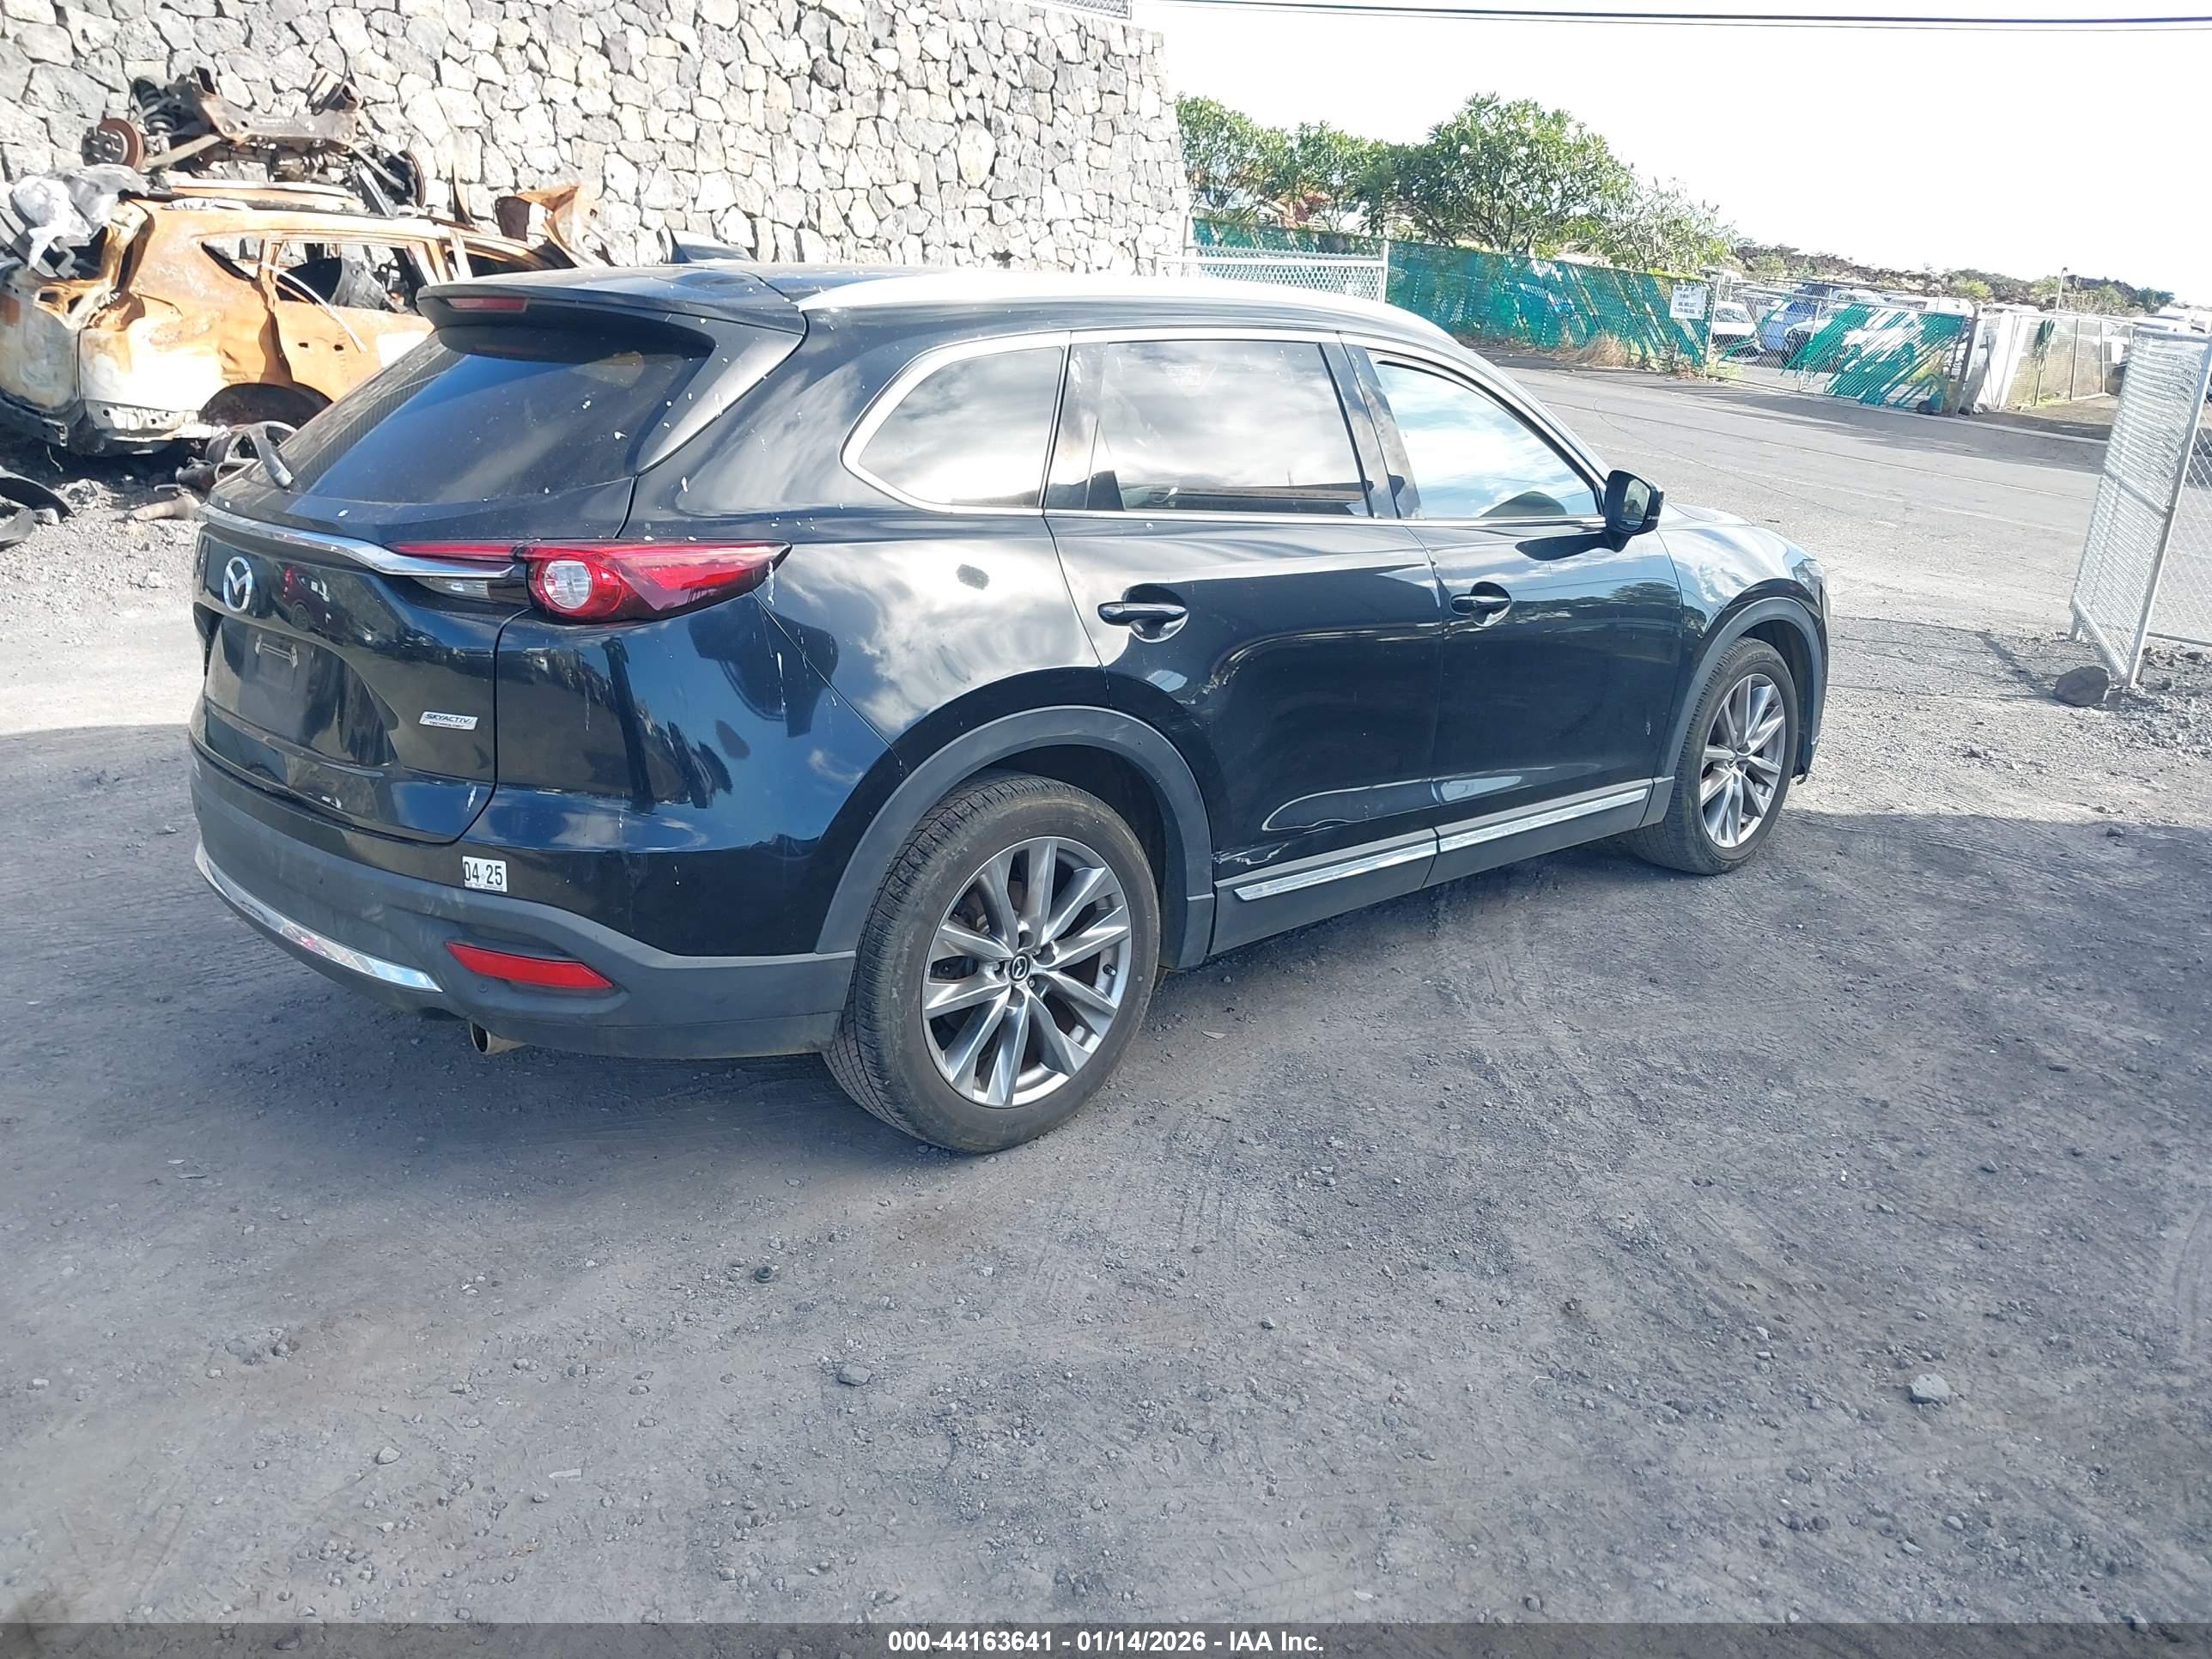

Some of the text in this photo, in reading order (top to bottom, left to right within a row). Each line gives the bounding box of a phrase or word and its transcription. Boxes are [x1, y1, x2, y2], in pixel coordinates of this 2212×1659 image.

[425, 713, 471, 724] SKYACTIV
[464, 861, 503, 886] 04 25
